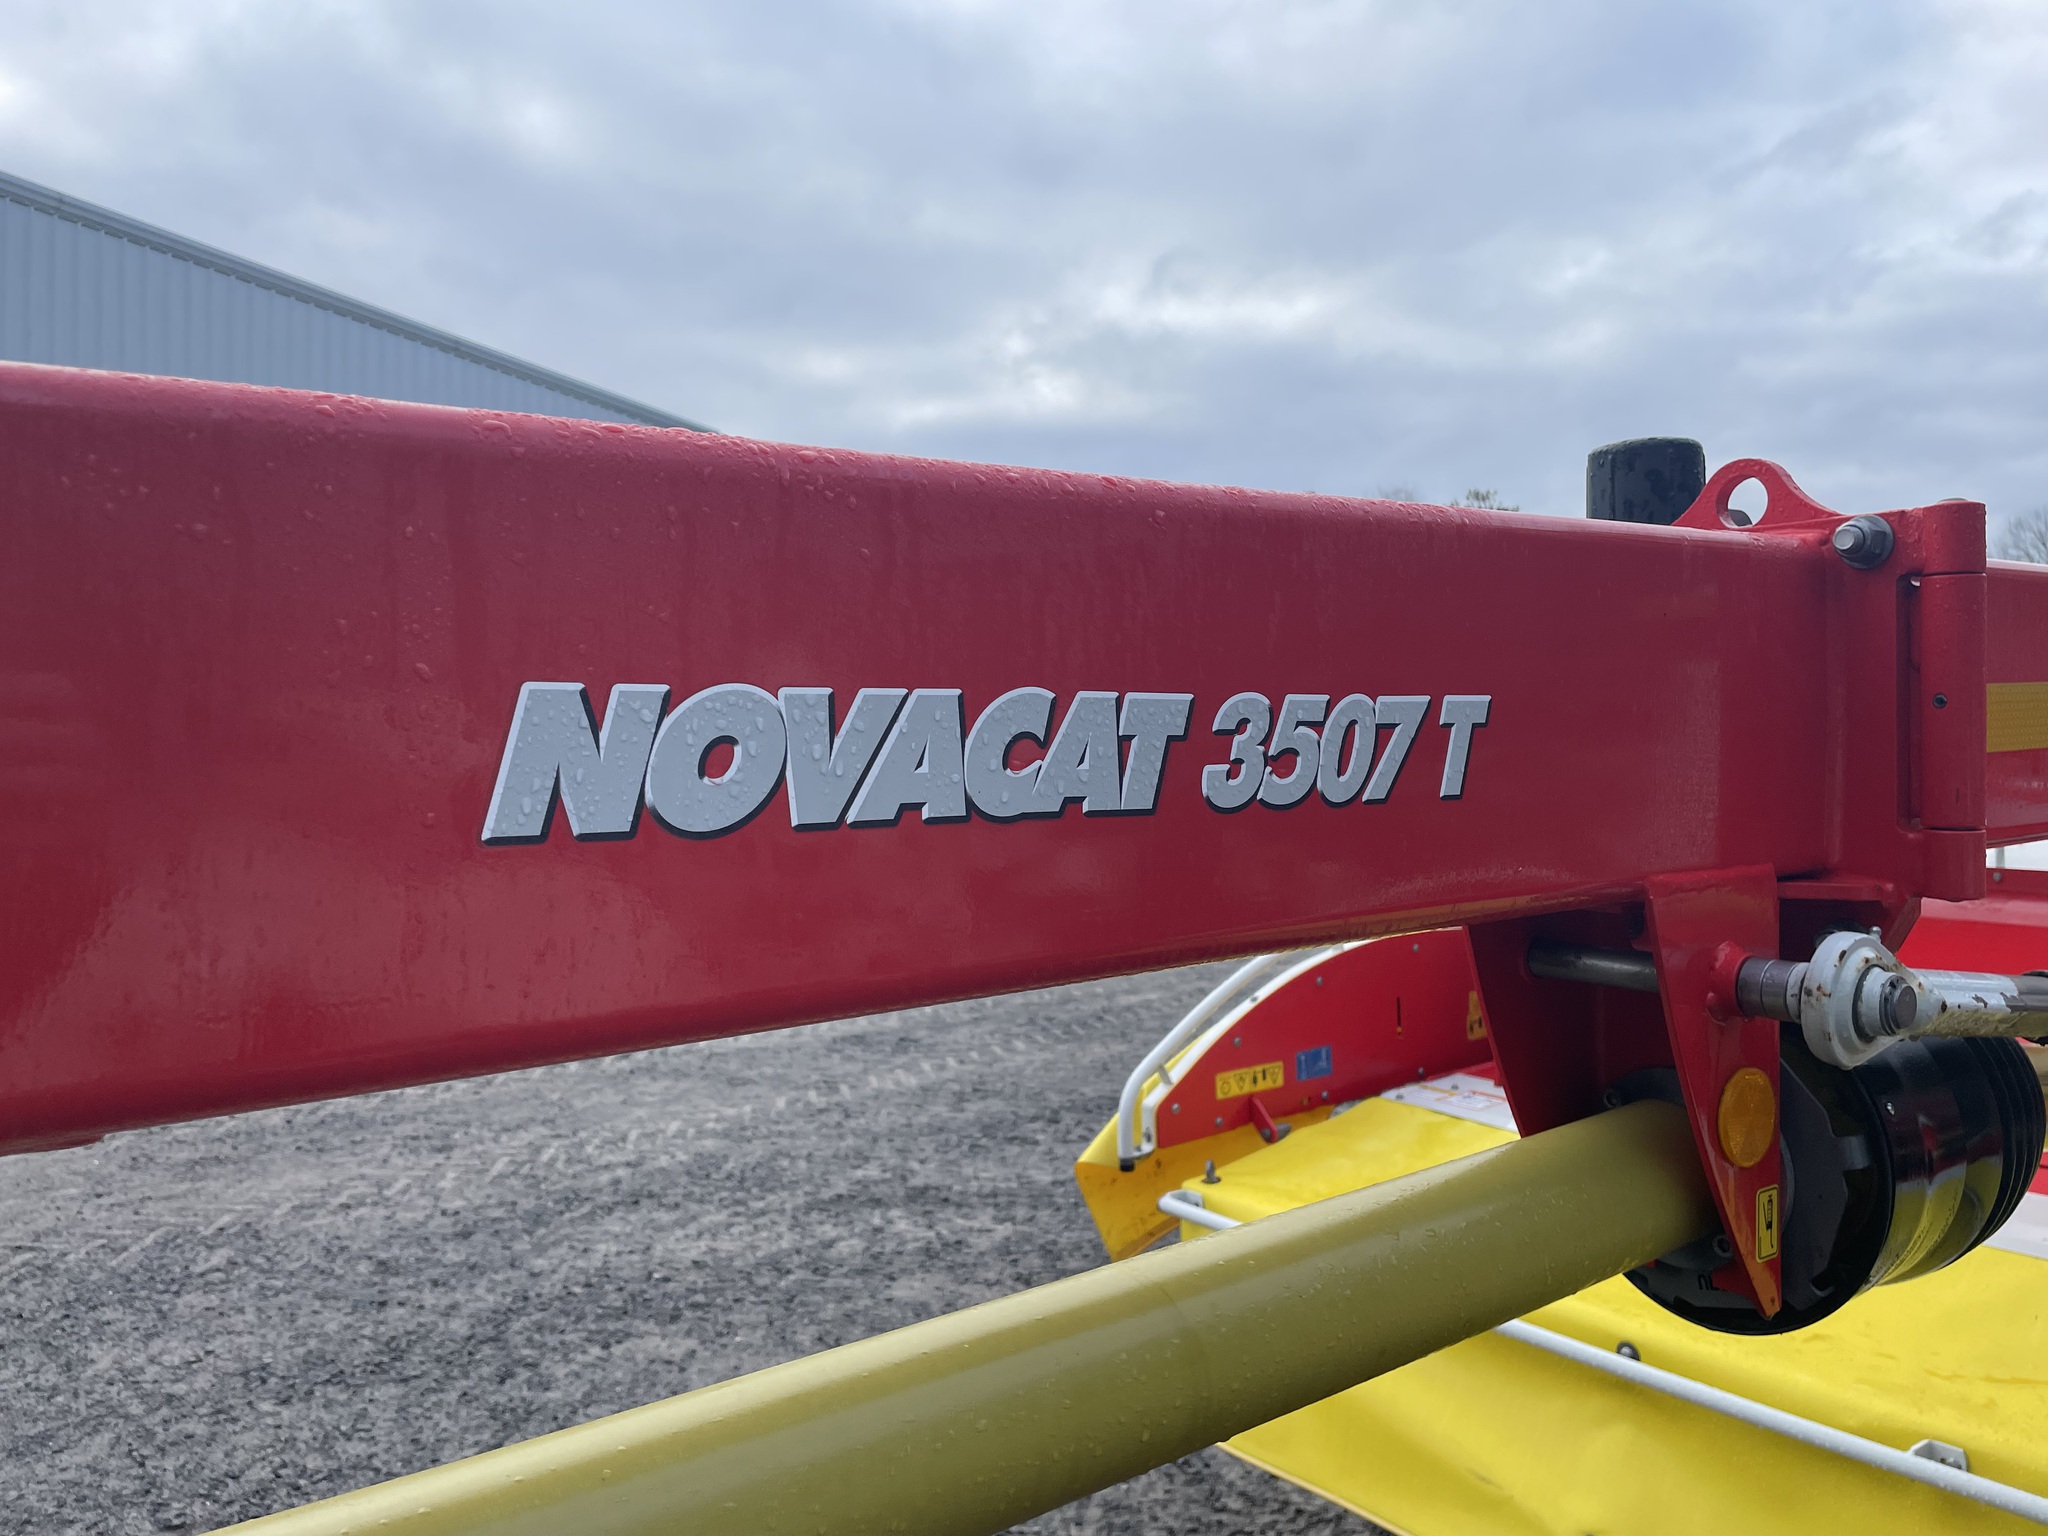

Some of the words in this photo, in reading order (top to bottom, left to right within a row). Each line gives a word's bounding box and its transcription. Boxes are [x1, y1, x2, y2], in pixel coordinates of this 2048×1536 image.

[481, 681, 1194, 845] NOVACAT
[1201, 692, 1431, 813] 3507
[1439, 694, 1492, 800] T
